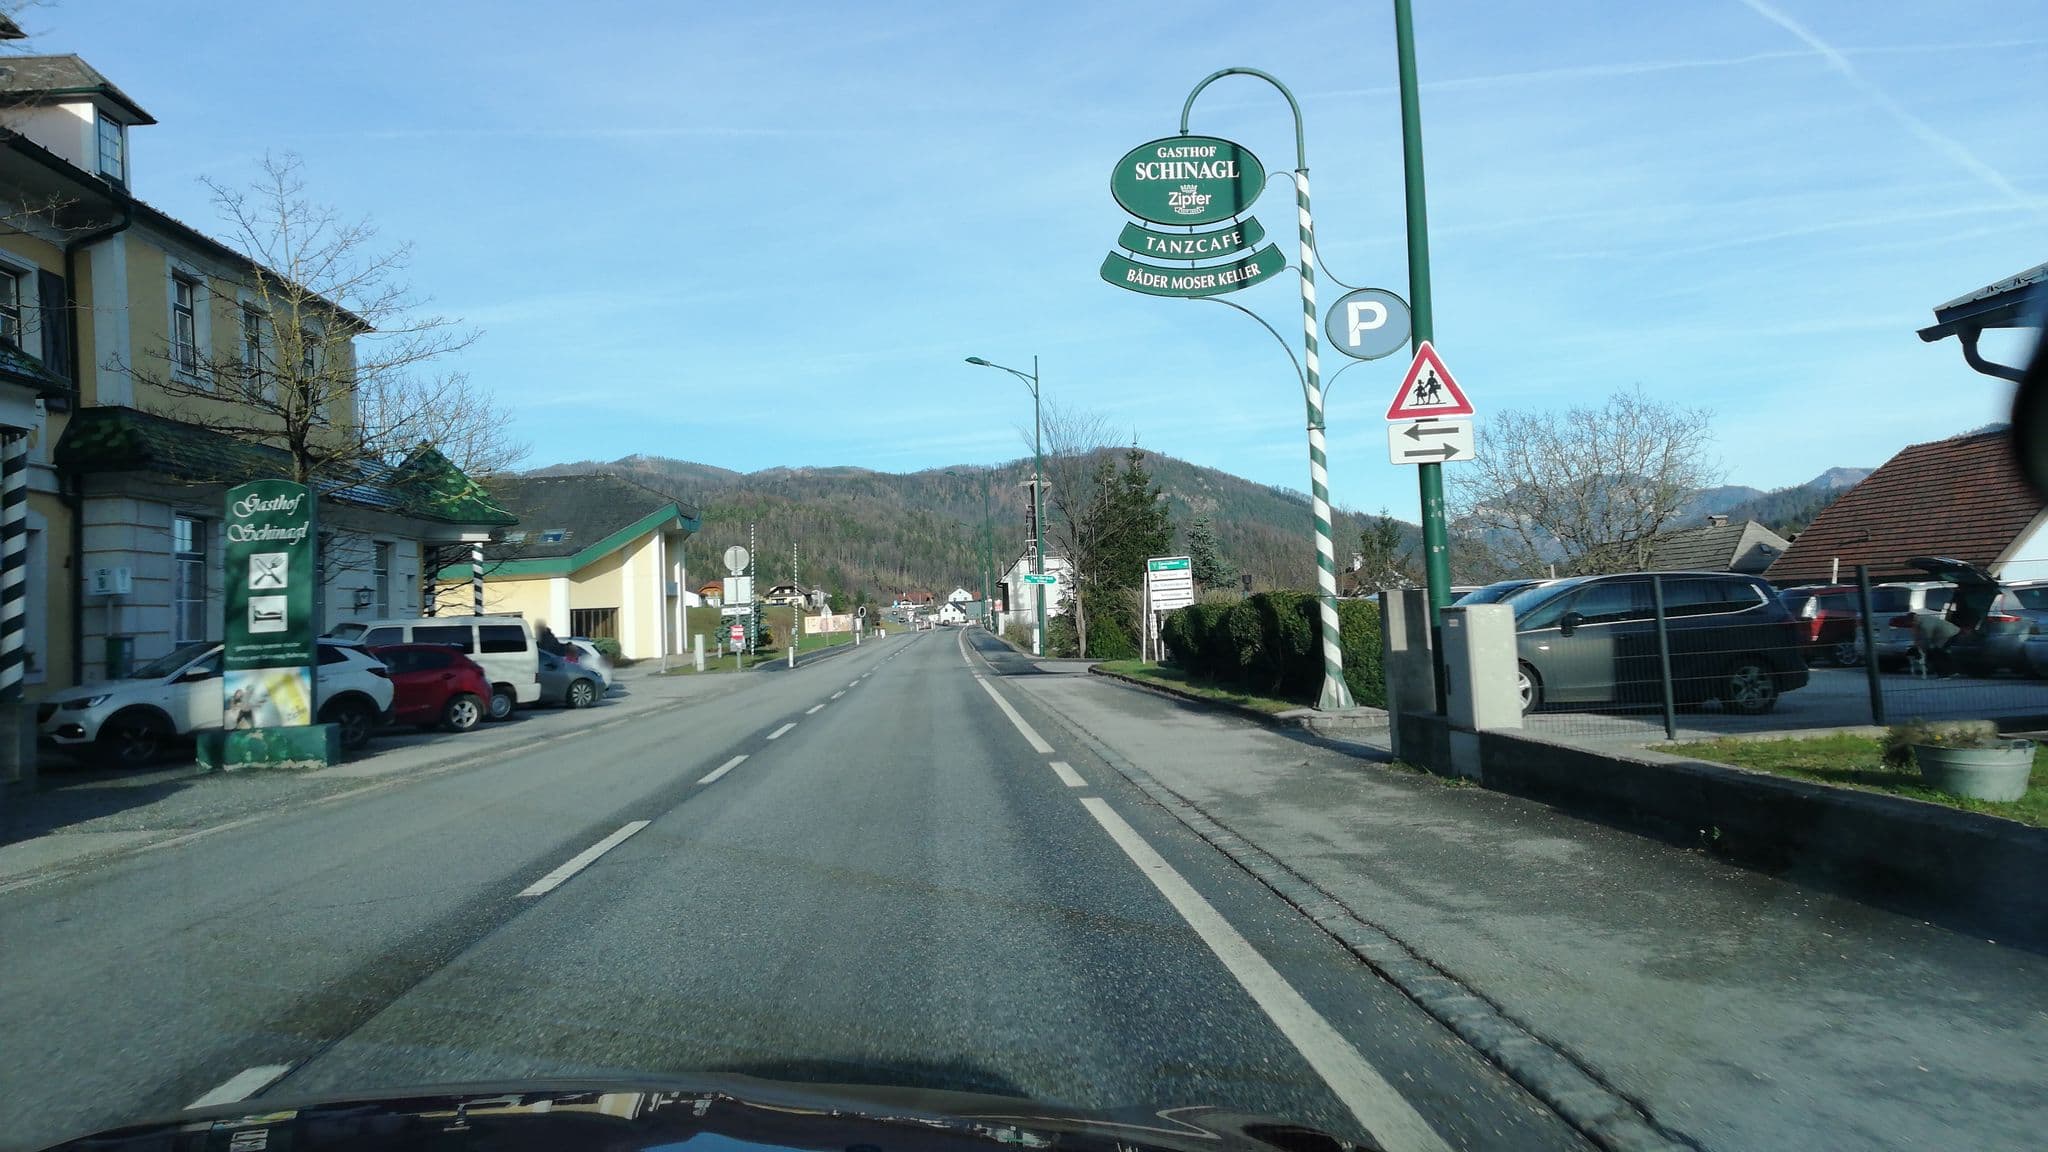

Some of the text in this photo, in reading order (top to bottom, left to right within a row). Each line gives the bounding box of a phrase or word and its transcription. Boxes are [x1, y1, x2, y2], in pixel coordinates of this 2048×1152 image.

[1157, 146, 1217, 158] GASTHOF
[1135, 160, 1240, 181] SCHINAGL
[1168, 192, 1212, 208] Zipfer
[1146, 231, 1243, 254] TANZCAFE
[1171, 275, 1216, 290] MOSER
[1218, 263, 1262, 286] KELLER
[1347, 301, 1388, 347] P
[232, 493, 306, 518] Gasthof
[227, 521, 310, 545] Schinagl
